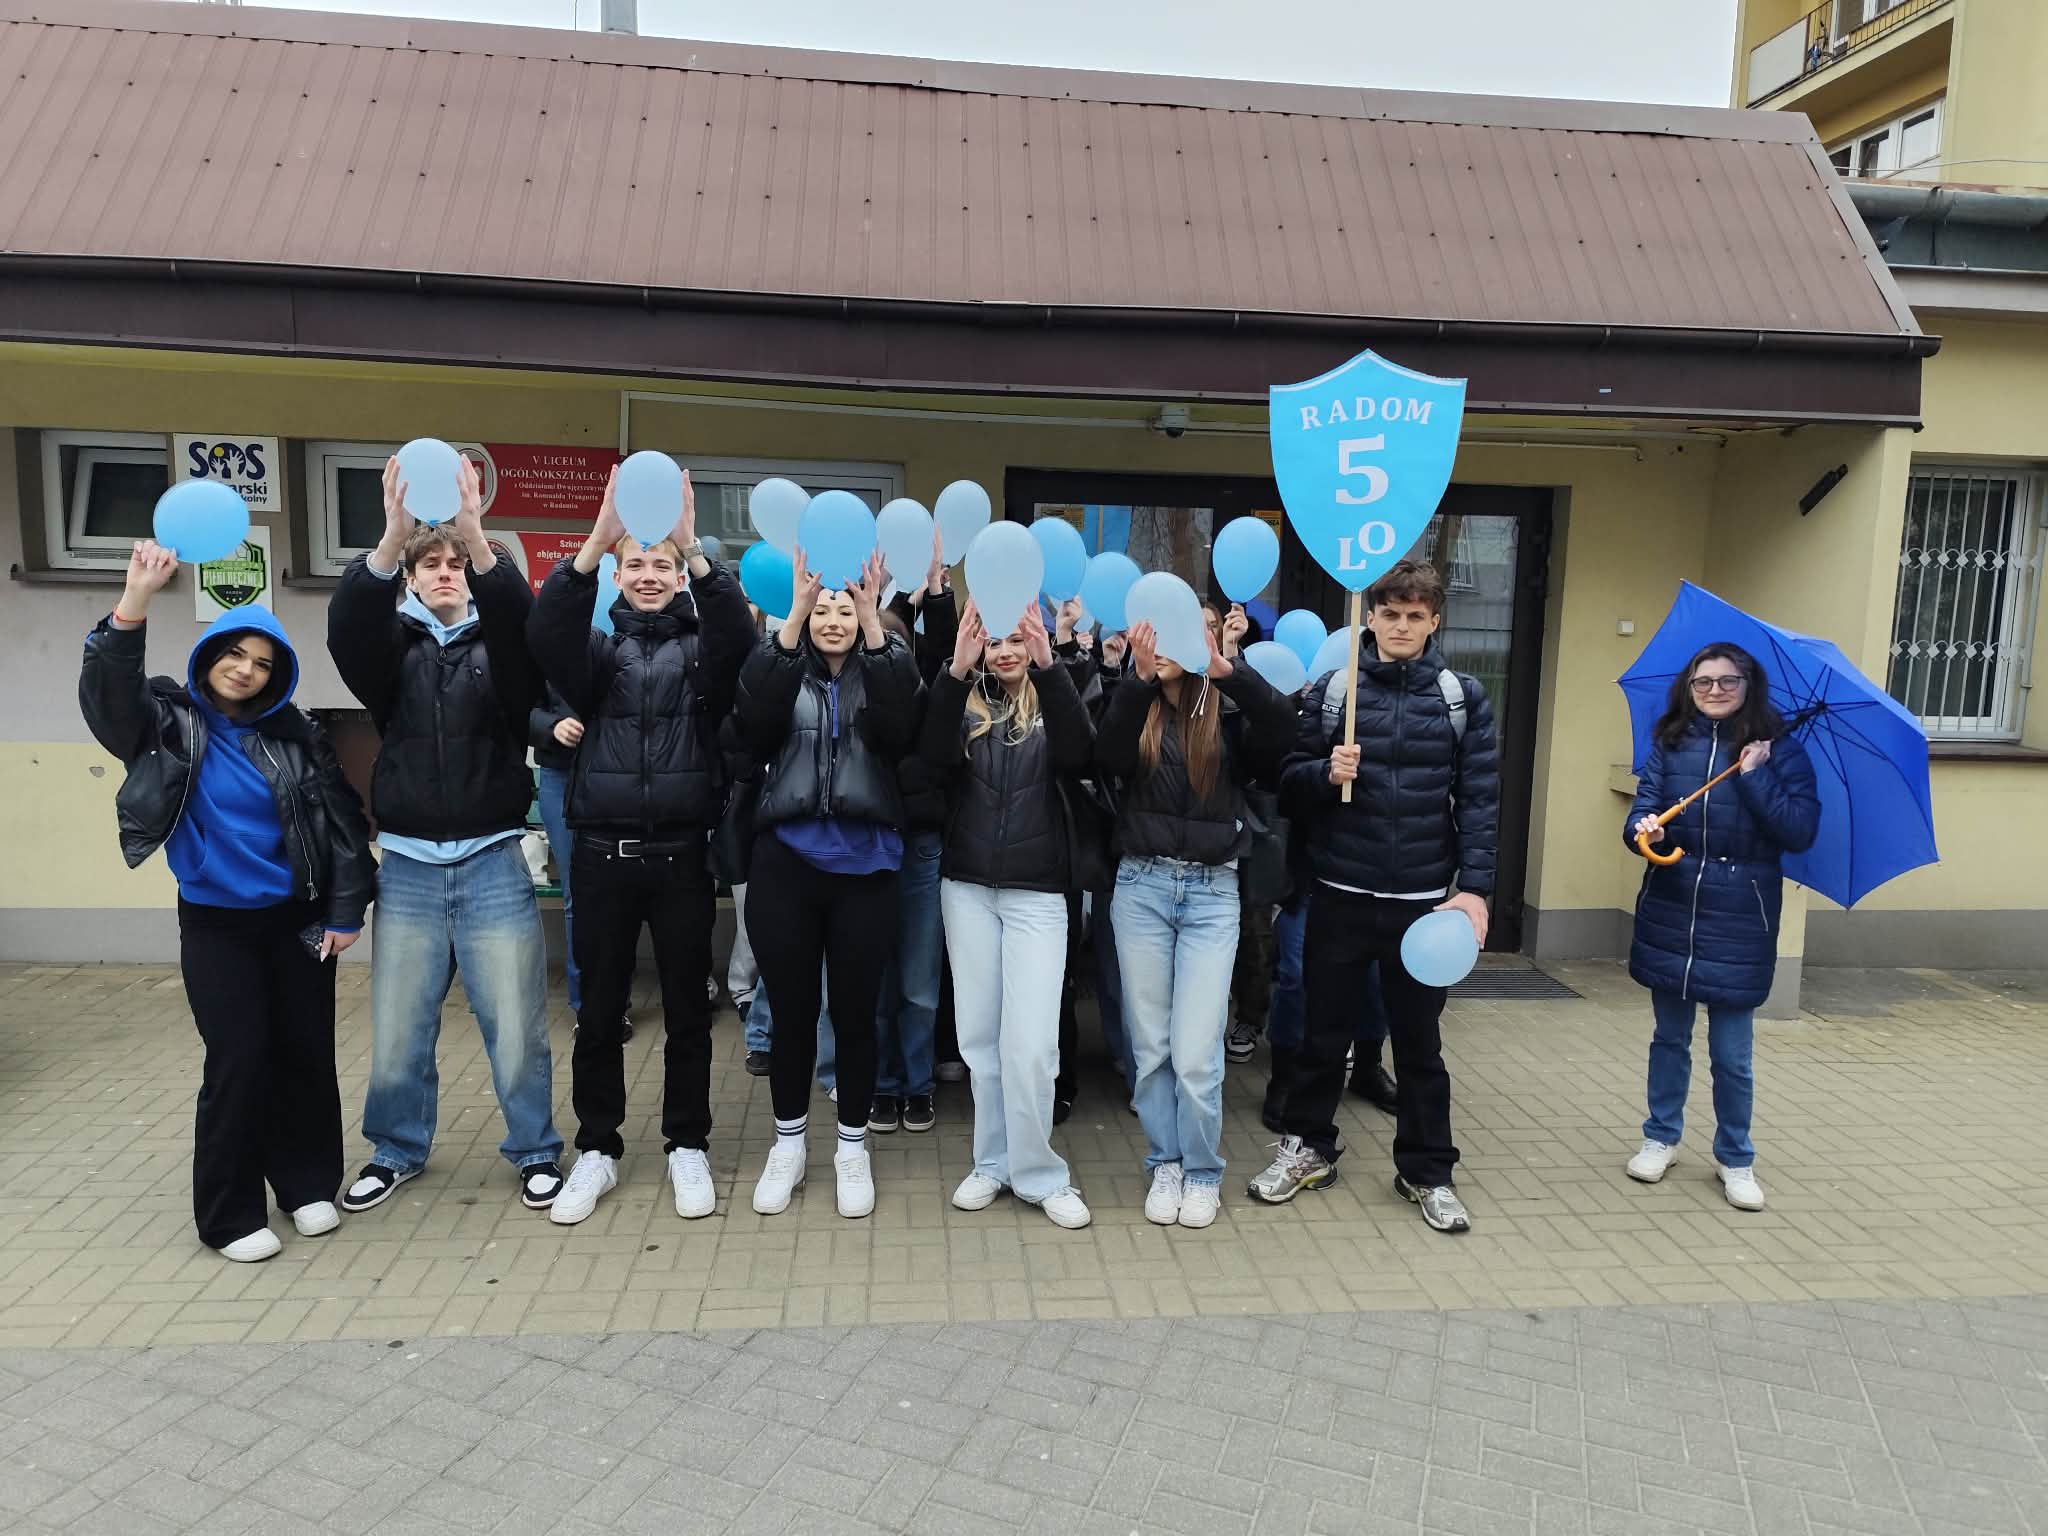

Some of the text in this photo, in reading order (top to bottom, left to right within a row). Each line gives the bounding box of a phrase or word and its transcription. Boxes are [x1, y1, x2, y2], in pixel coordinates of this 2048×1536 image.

[1301, 396, 1434, 430] RADOM
[188, 441, 266, 480] SOS
[532, 455, 587, 467] V LICEUM
[1335, 433, 1390, 505] 5
[228, 481, 268, 494] arski
[1337, 521, 1396, 571] LO
